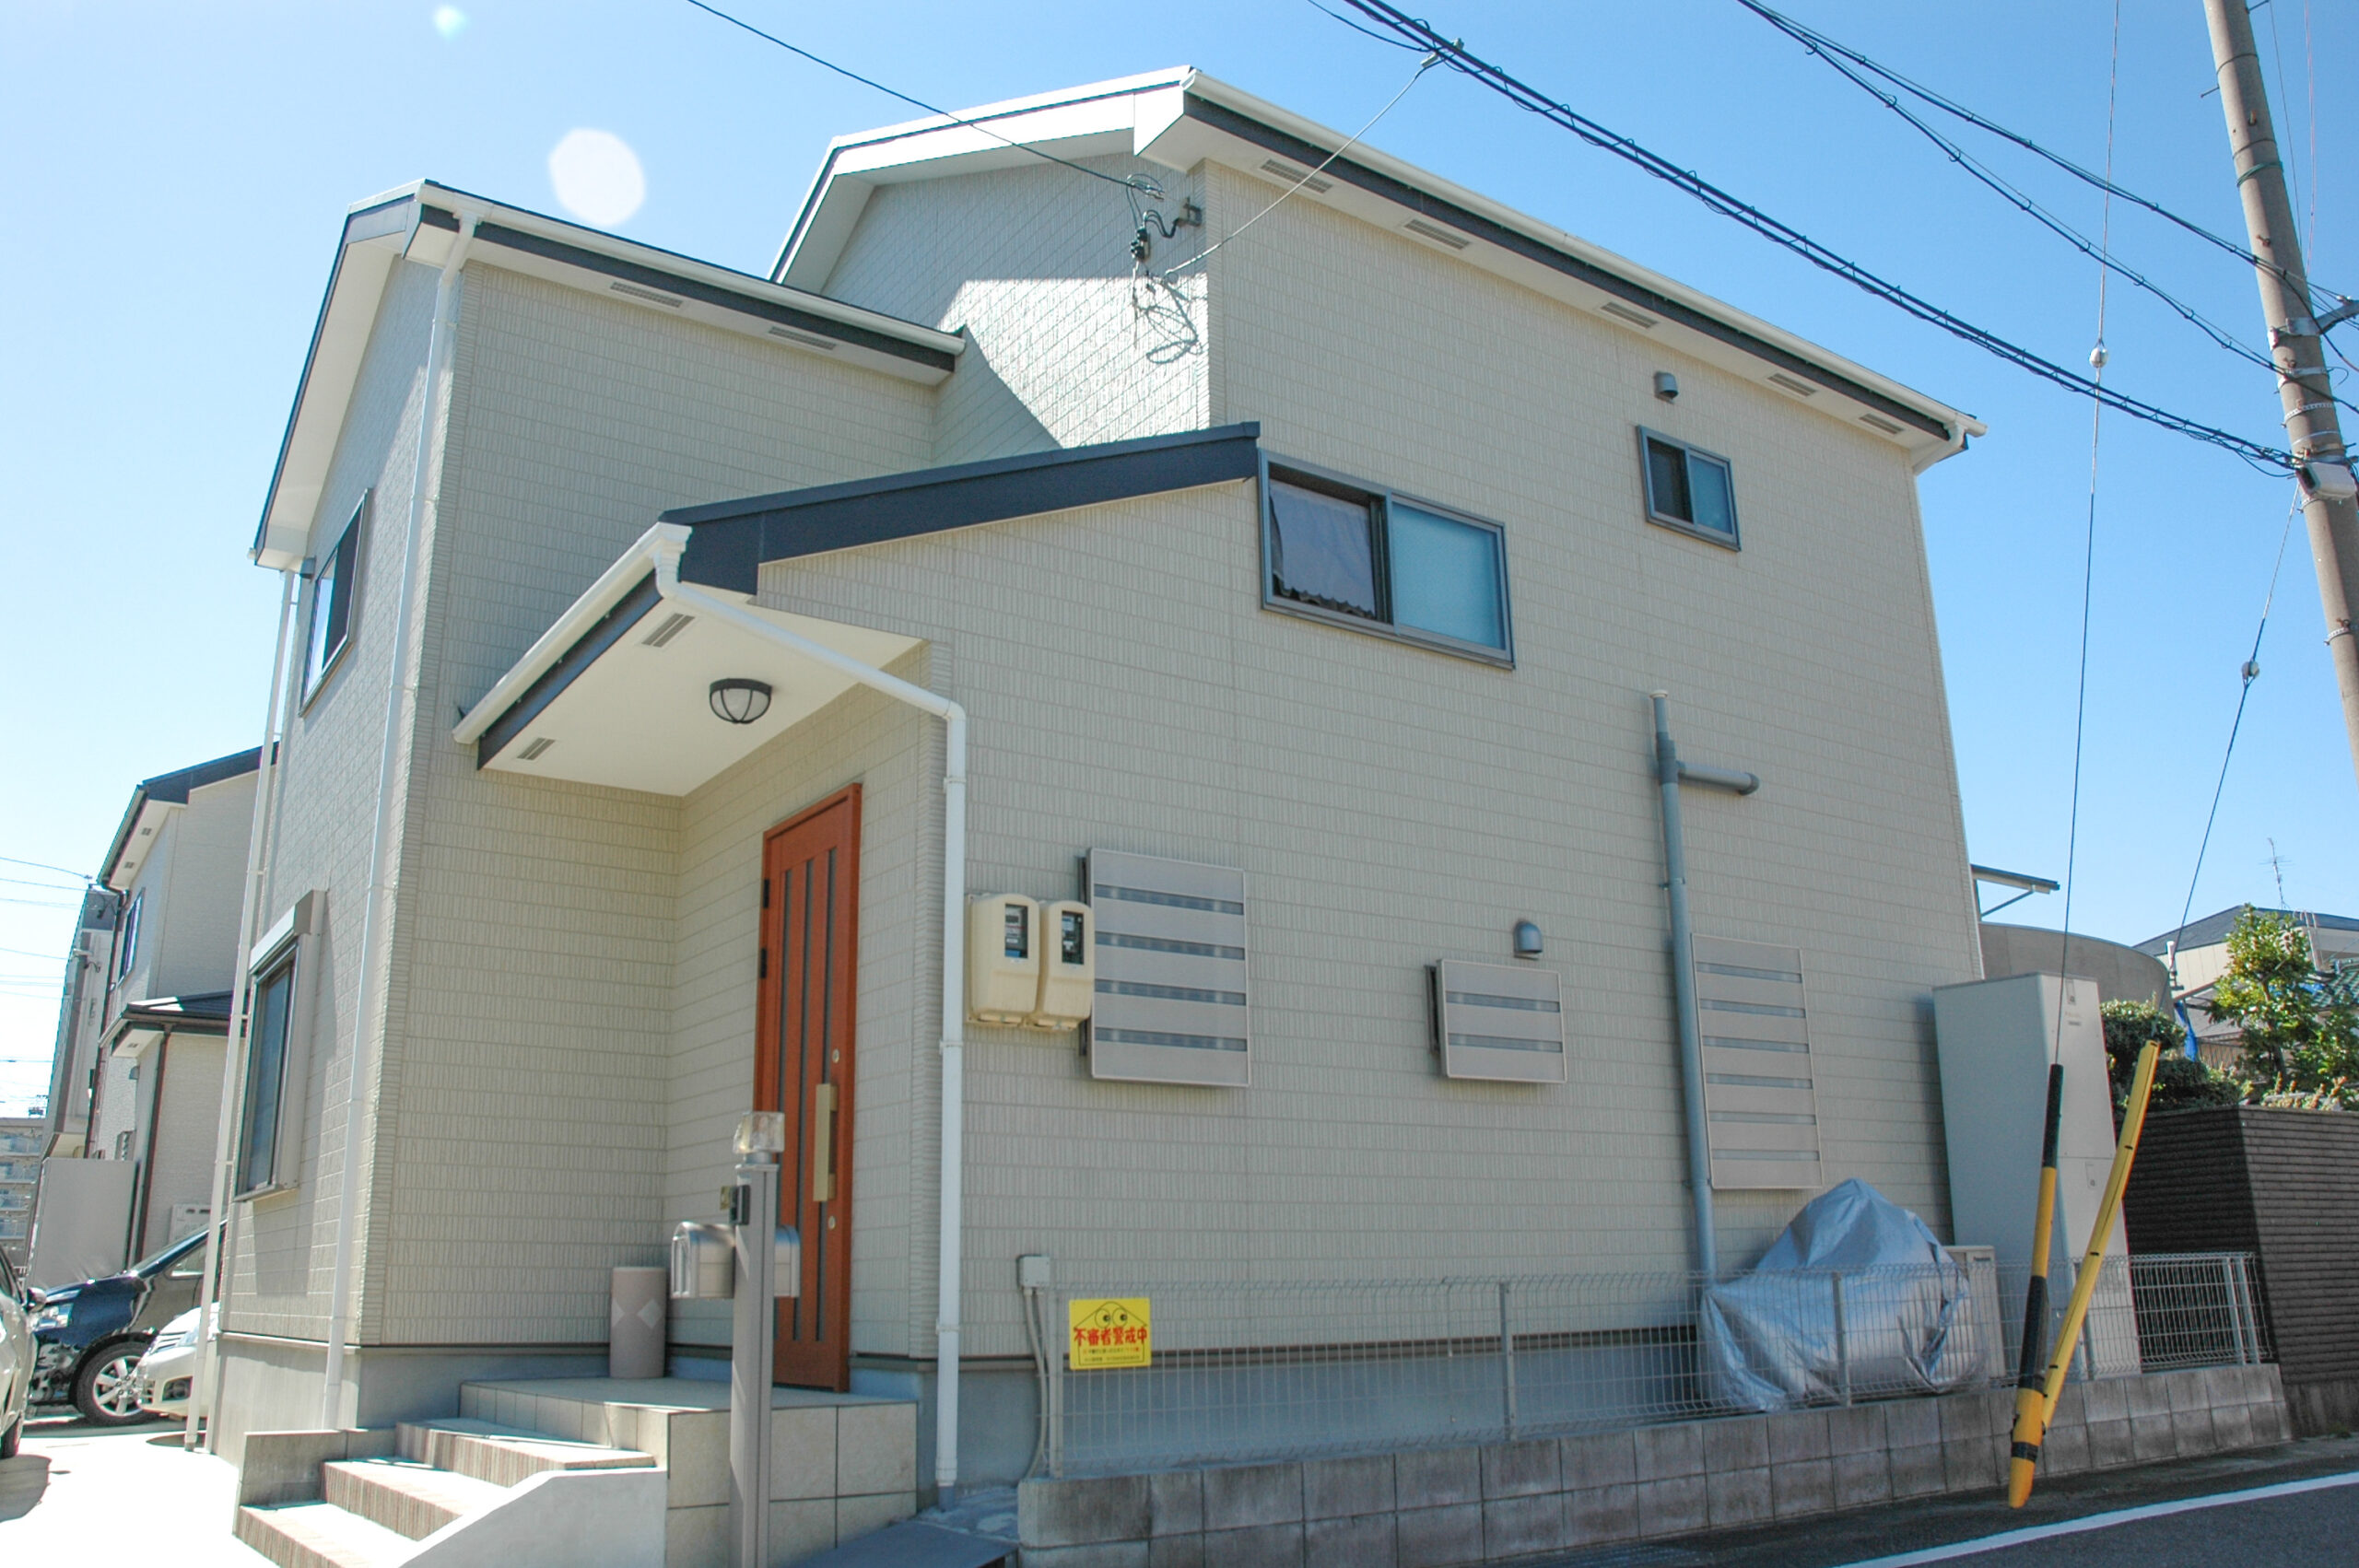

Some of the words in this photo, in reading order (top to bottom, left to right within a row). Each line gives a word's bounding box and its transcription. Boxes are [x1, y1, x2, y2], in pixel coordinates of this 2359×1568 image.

[1074, 1327, 1147, 1346] 不審者警戒中
